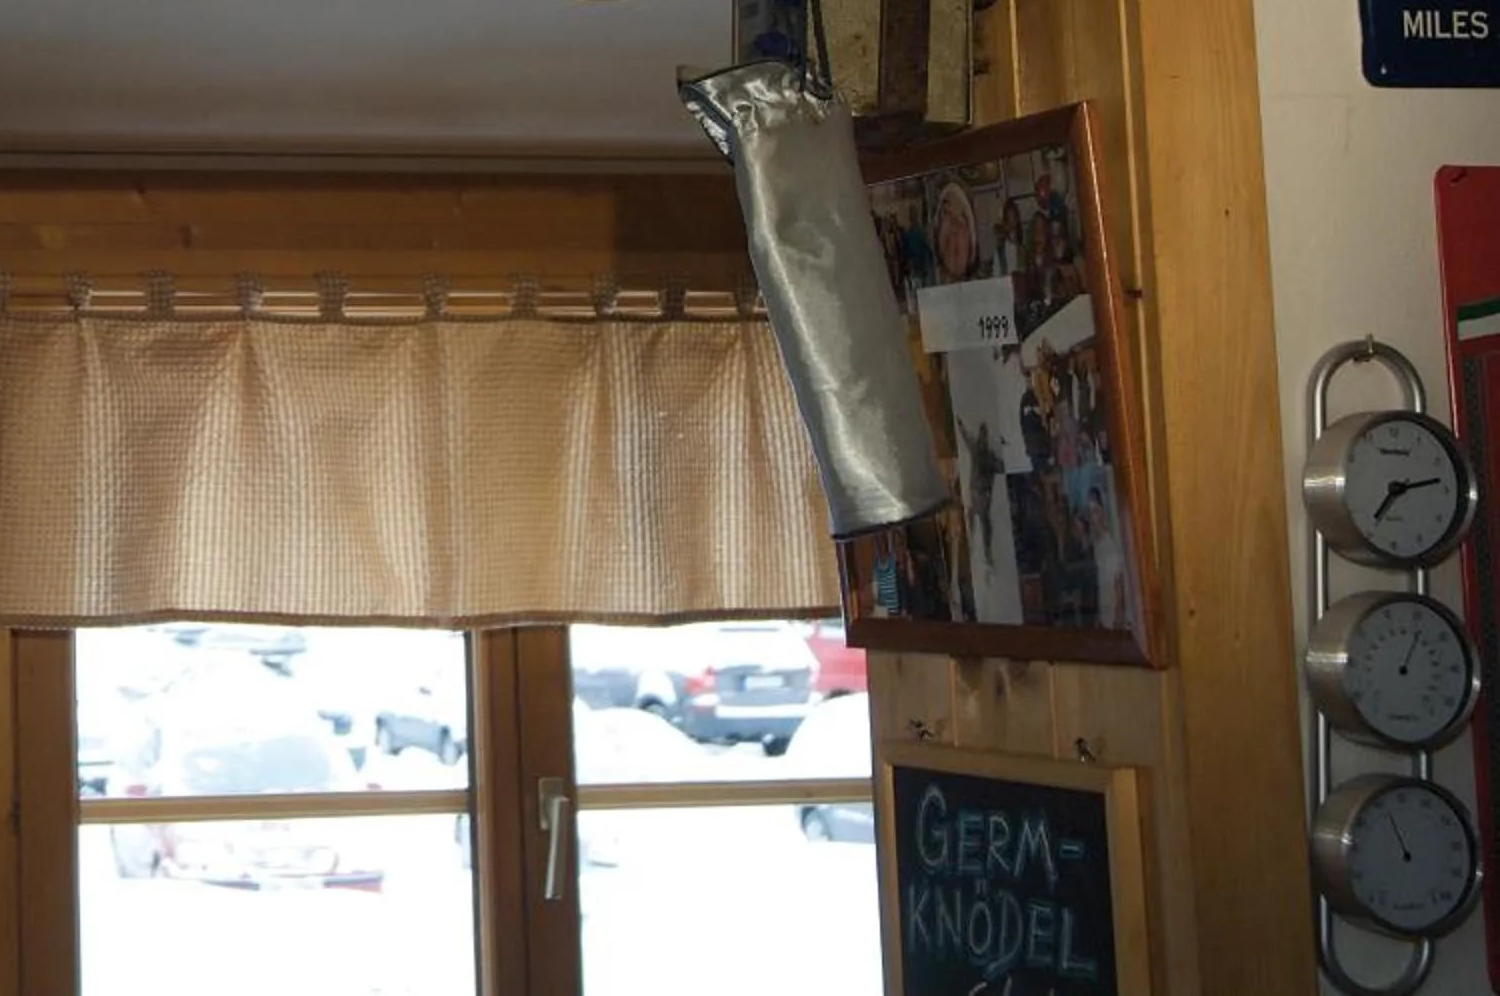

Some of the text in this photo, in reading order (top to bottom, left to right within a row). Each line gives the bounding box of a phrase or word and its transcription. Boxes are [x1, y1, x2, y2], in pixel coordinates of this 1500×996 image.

[1402, 9, 1490, 40] MILES
[978, 315, 1010, 339] 1999
[915, 782, 1086, 884] GERM-
